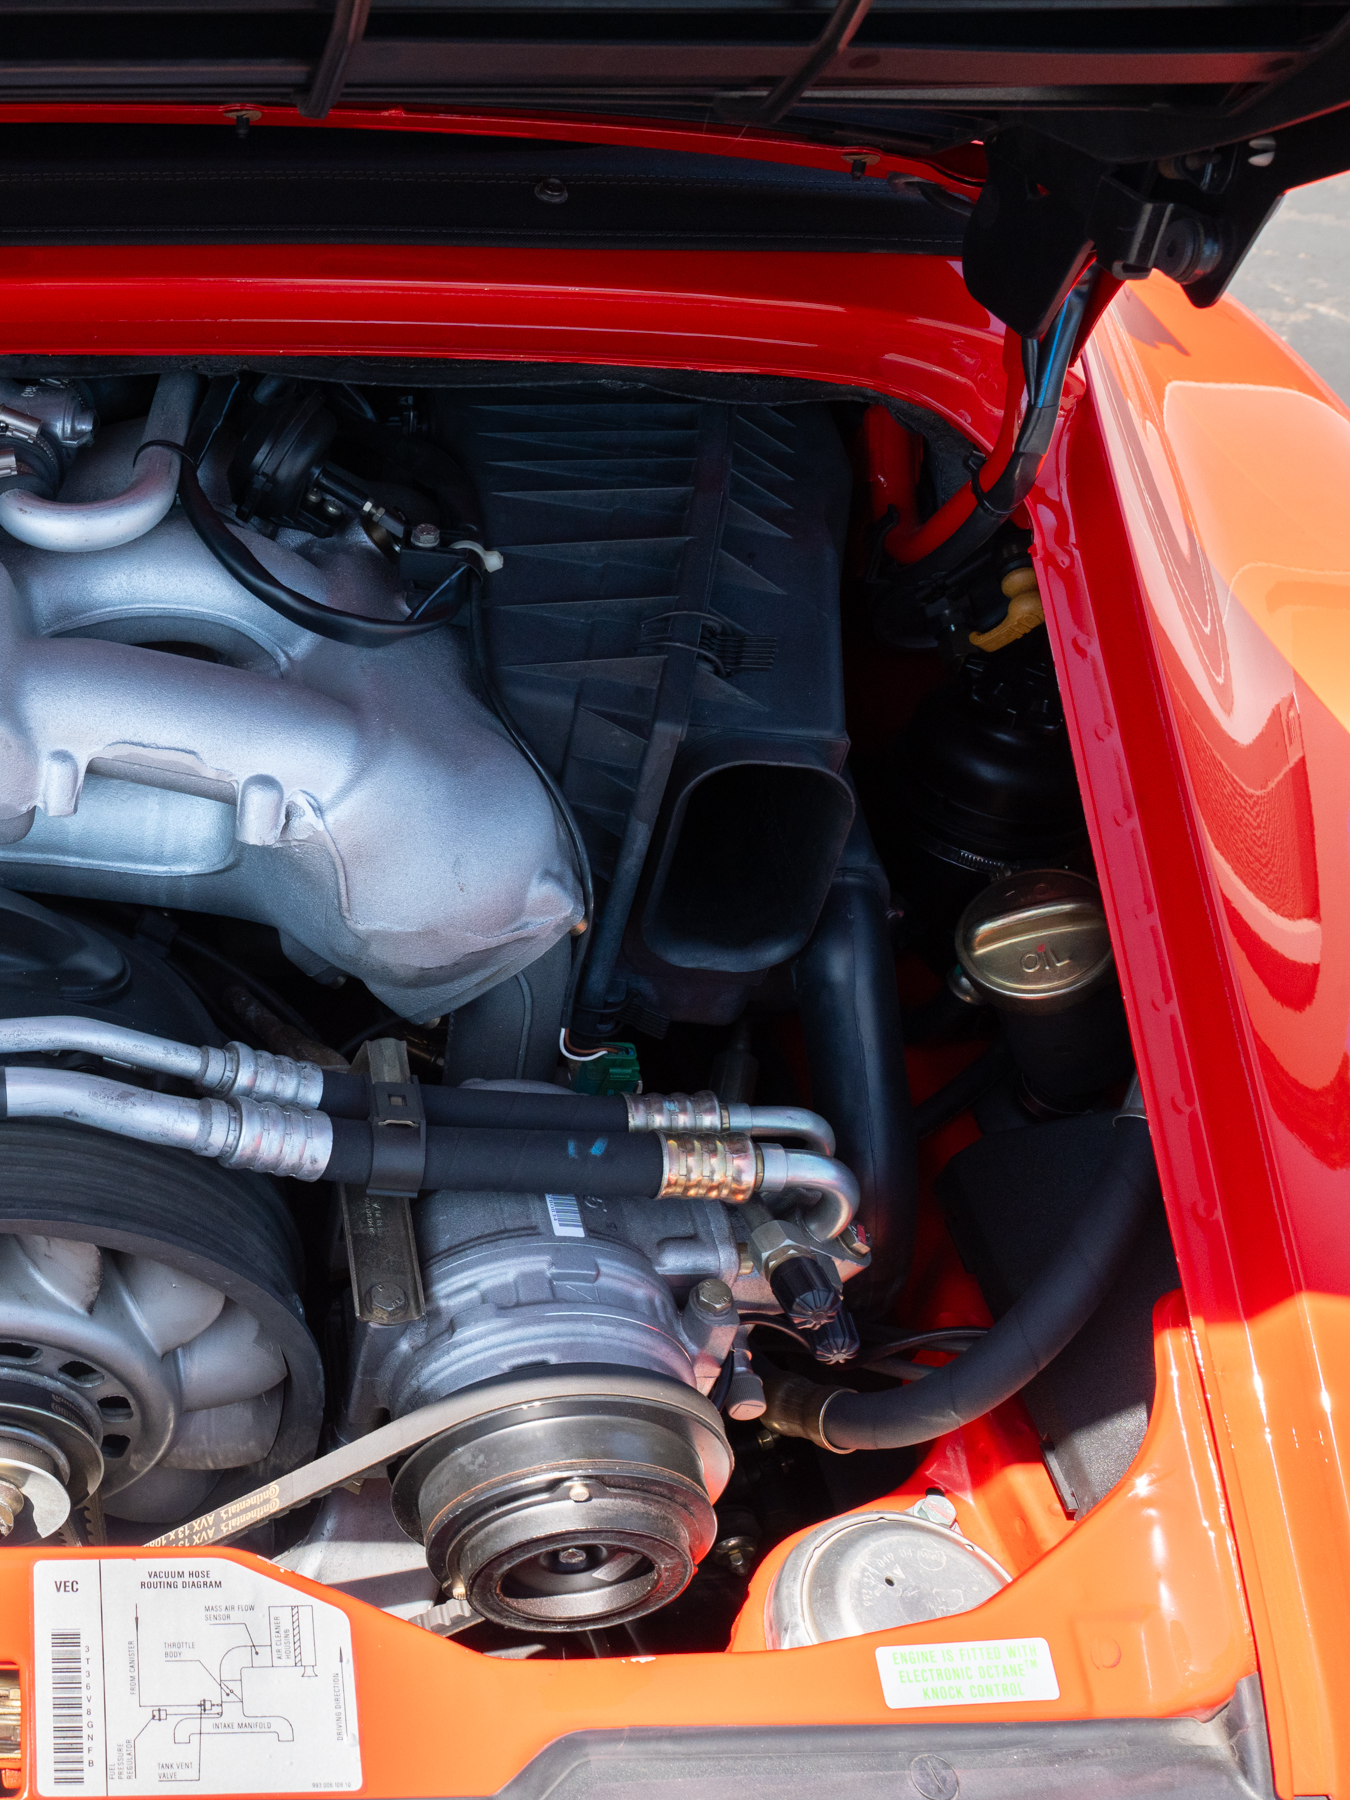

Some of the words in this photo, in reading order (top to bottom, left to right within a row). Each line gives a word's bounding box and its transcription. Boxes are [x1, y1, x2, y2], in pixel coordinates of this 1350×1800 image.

[1021, 948, 1070, 973] OIL
[226, 1484, 280, 1518] Continental
[193, 1513, 215, 1529] AVX
[226, 1498, 280, 1532] Continental
[178, 1524, 190, 1538] 13
[193, 1526, 215, 1544] AVX
[147, 1570, 185, 1579] VACUUM
[188, 1570, 211, 1578] HOSE
[55, 1581, 79, 1592] VEC
[141, 1581, 178, 1589] ROUTING
[182, 1580, 222, 1589] DIAGRAM
[892, 1650, 936, 1666] ENGINE
[942, 1649, 954, 1662] IS
[960, 1646, 1001, 1661] FITTED
[1006, 1644, 1038, 1659] WITH
[898, 1667, 973, 1684] ELECTRONIC
[922, 1685, 964, 1700] KNOCK
[970, 1683, 1025, 1698] CONTROL
[212, 1722, 235, 1730] INTAKE
[237, 1722, 271, 1730] MANIFOLD
